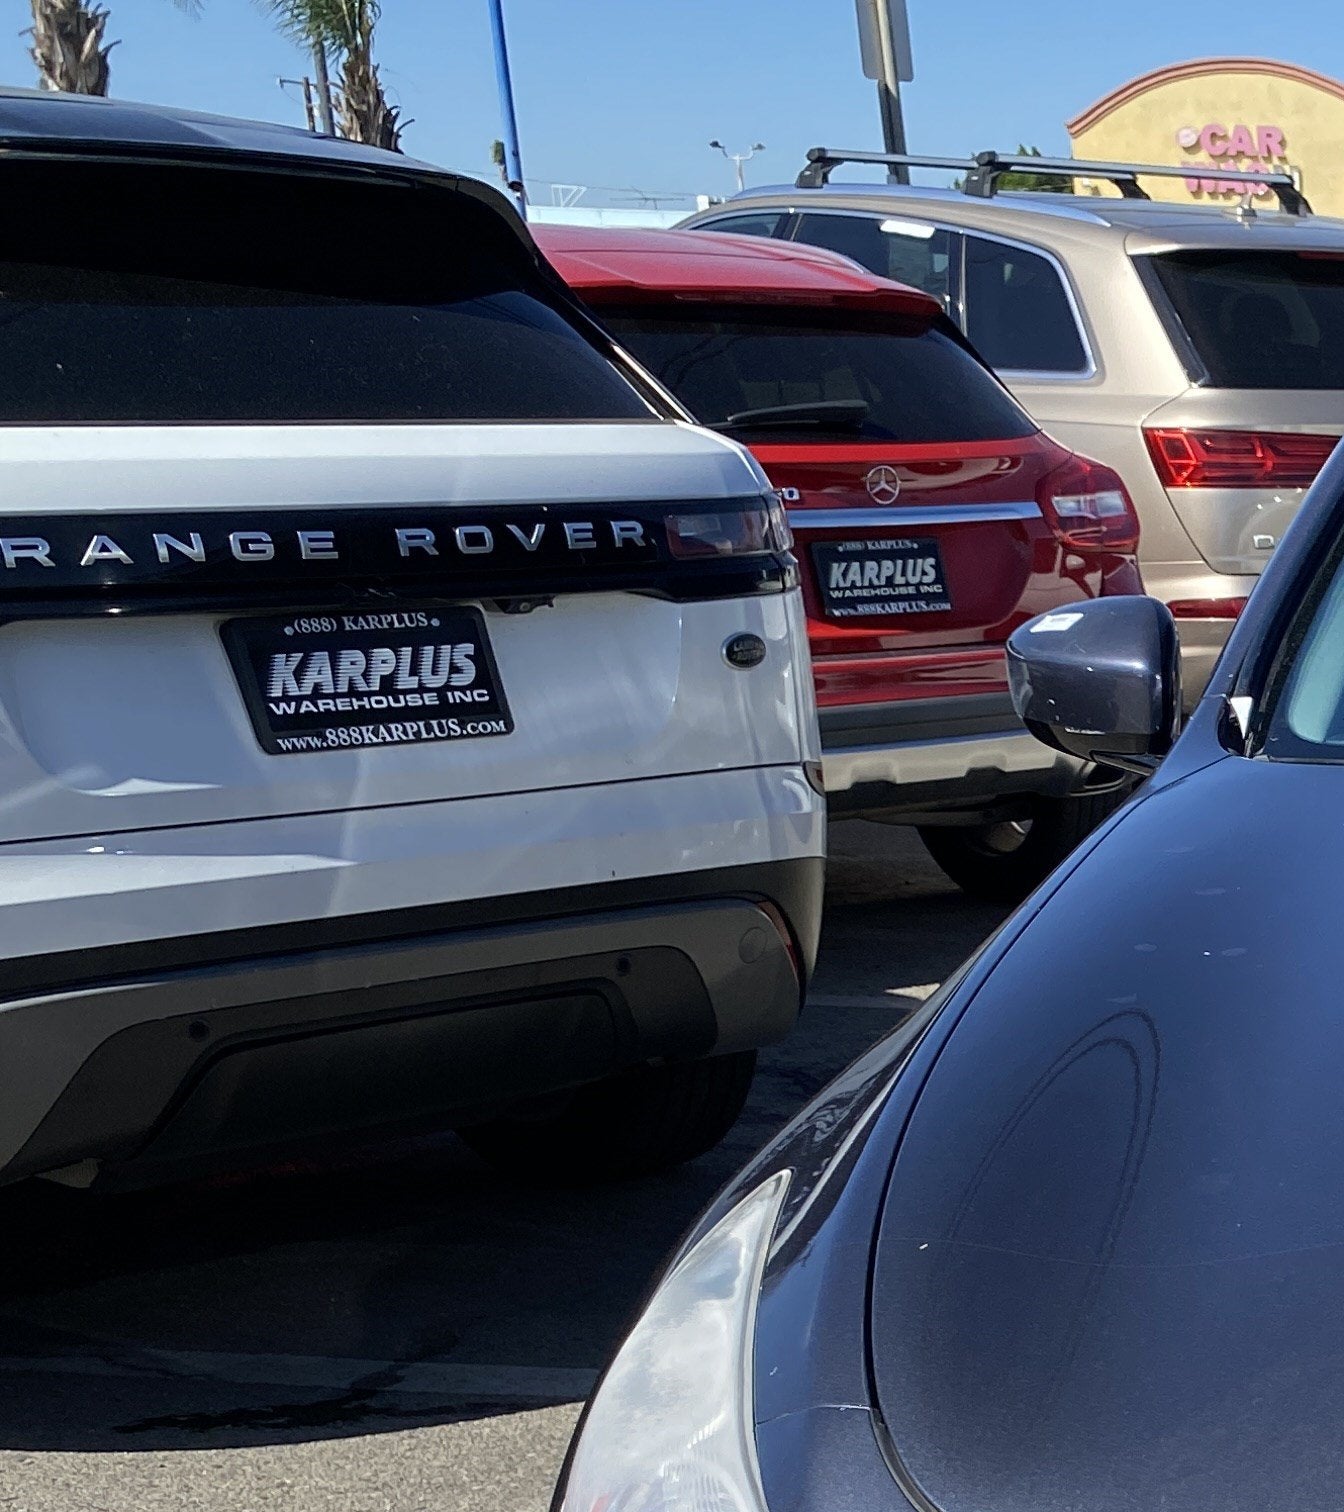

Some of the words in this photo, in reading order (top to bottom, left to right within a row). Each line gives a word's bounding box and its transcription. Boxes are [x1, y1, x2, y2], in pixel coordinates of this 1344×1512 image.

[1201, 123, 1286, 156] CAR
[0, 530, 339, 568] RANGE
[396, 521, 647, 557] ROVER
[867, 538, 914, 550] KARPLUS
[829, 557, 937, 589] KARPLUS
[829, 586, 917, 599] WAREHOUSE
[919, 583, 944, 594] INC
[294, 617, 337, 634] (888)
[343, 612, 429, 632] KARPLUS
[265, 643, 475, 698] KARPLUS
[268, 692, 440, 715] WAREHOUSE
[447, 689, 490, 704] INC
